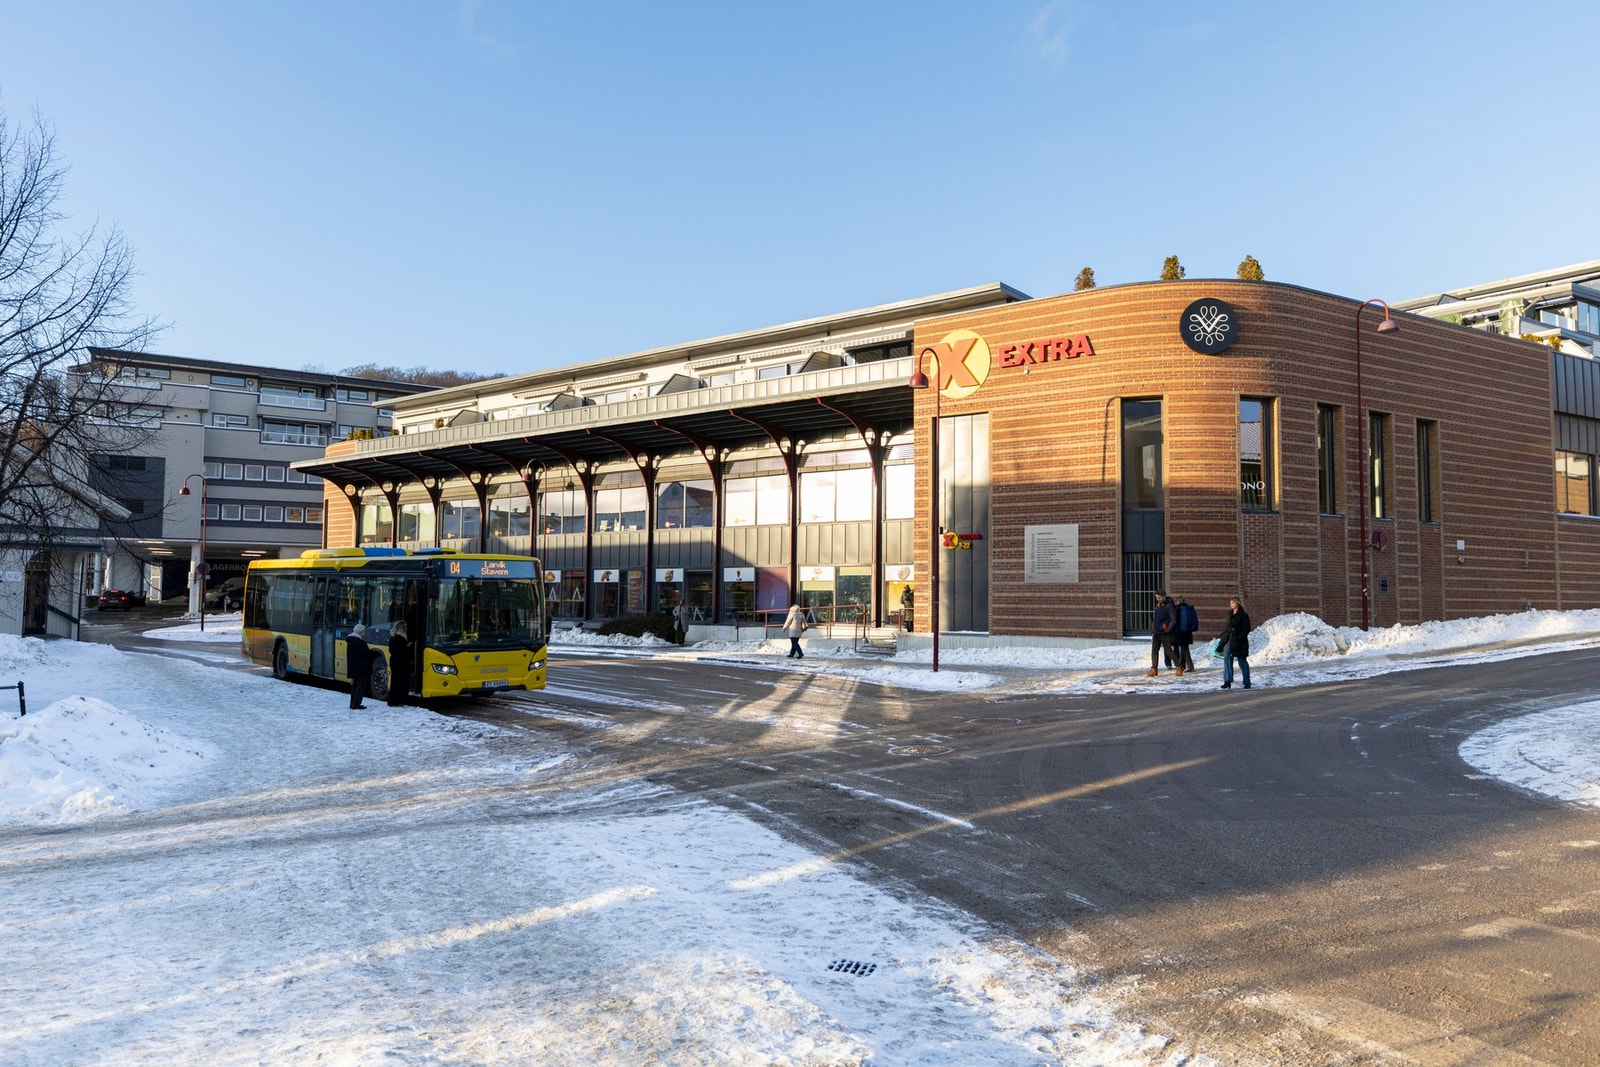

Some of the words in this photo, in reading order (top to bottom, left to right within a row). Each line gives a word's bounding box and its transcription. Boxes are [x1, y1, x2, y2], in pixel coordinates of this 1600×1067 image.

[998, 334, 1095, 368] EXTRA
[450, 561, 461, 575] 04
[484, 560, 506, 569] Larvik
[480, 567, 509, 576] Stavern
